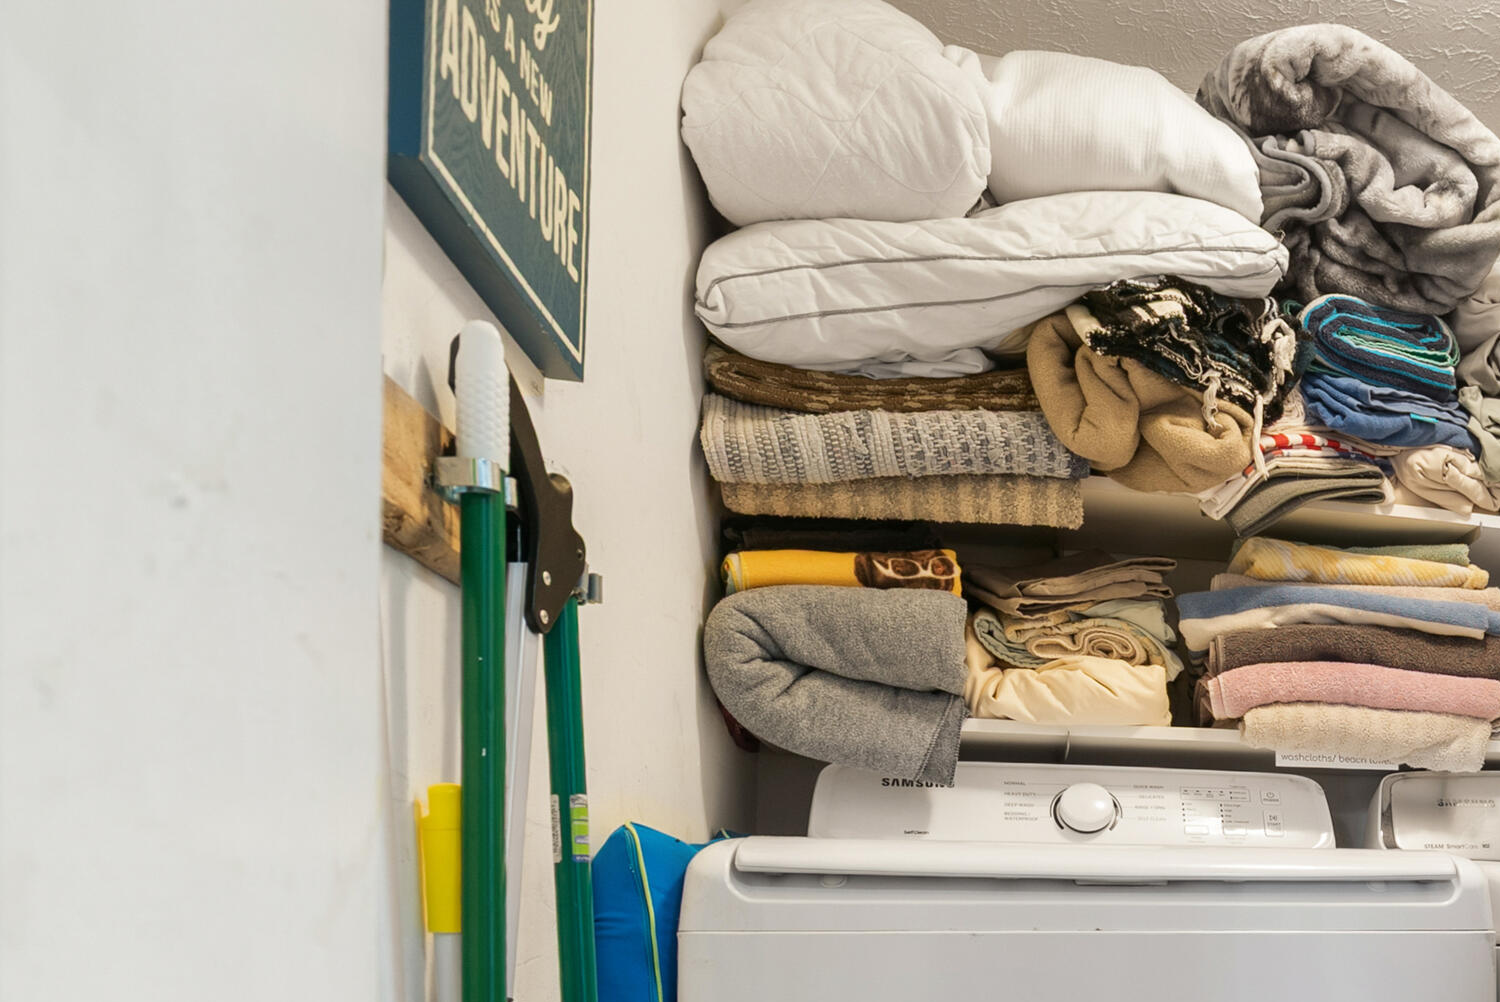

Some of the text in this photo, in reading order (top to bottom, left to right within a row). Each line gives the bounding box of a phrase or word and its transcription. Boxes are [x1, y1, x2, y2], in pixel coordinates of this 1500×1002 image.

[504, 13, 516, 64] A
[520, 38, 553, 126] NEW
[440, 0, 582, 283] ADVENTURE
[881, 777, 955, 788] SAMSU
[1281, 753, 1336, 764] washcloths/
